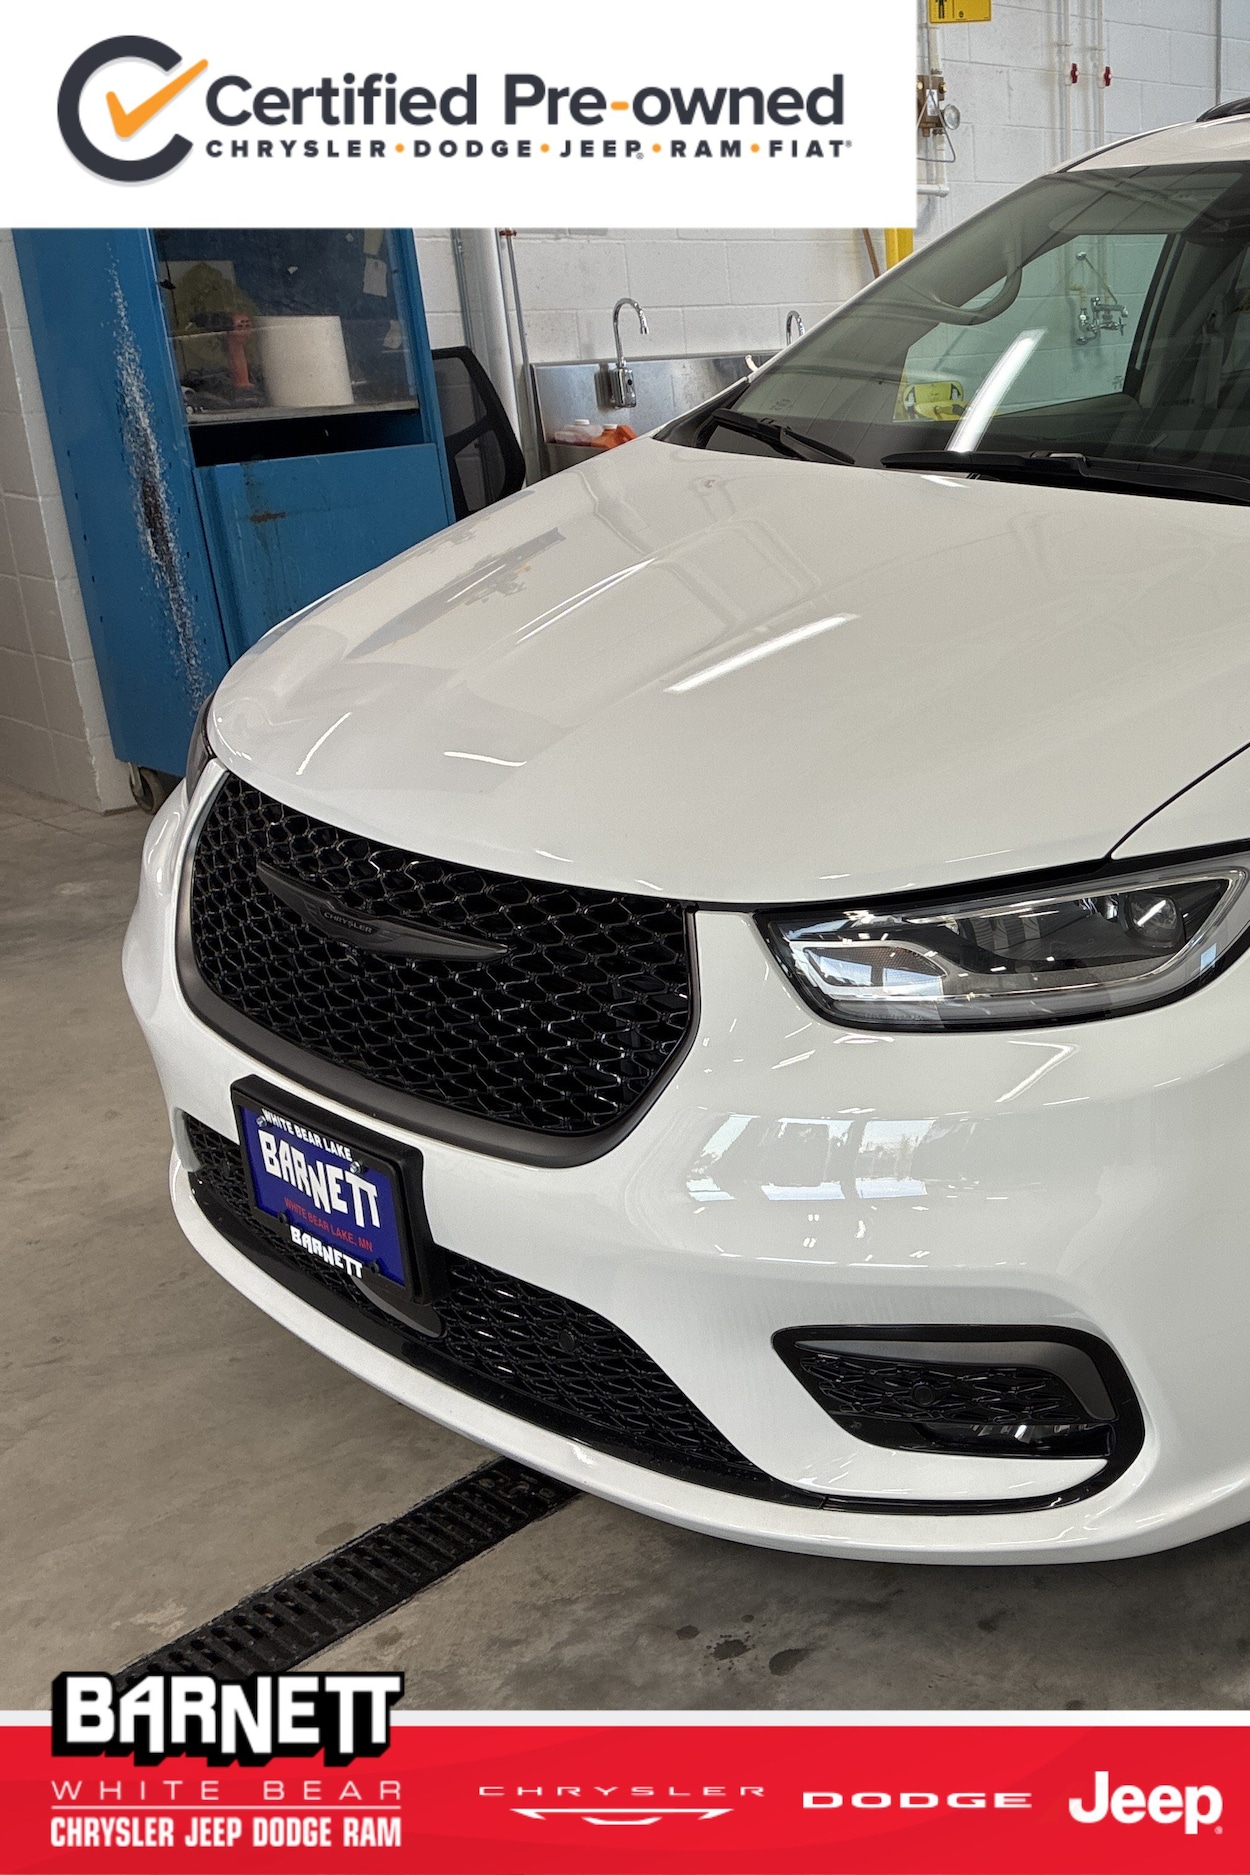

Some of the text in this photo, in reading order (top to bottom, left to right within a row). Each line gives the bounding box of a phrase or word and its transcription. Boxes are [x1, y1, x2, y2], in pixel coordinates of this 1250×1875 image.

[324, 911, 374, 934] CHRYSLER
[262, 1108, 353, 1162] WHITE BEAR LAKE
[258, 1129, 381, 1229] BARNETT
[284, 1197, 307, 1218] WHITE
[308, 1211, 331, 1230] BEAR
[358, 1234, 373, 1251] MN
[290, 1225, 363, 1279] BARNETT
